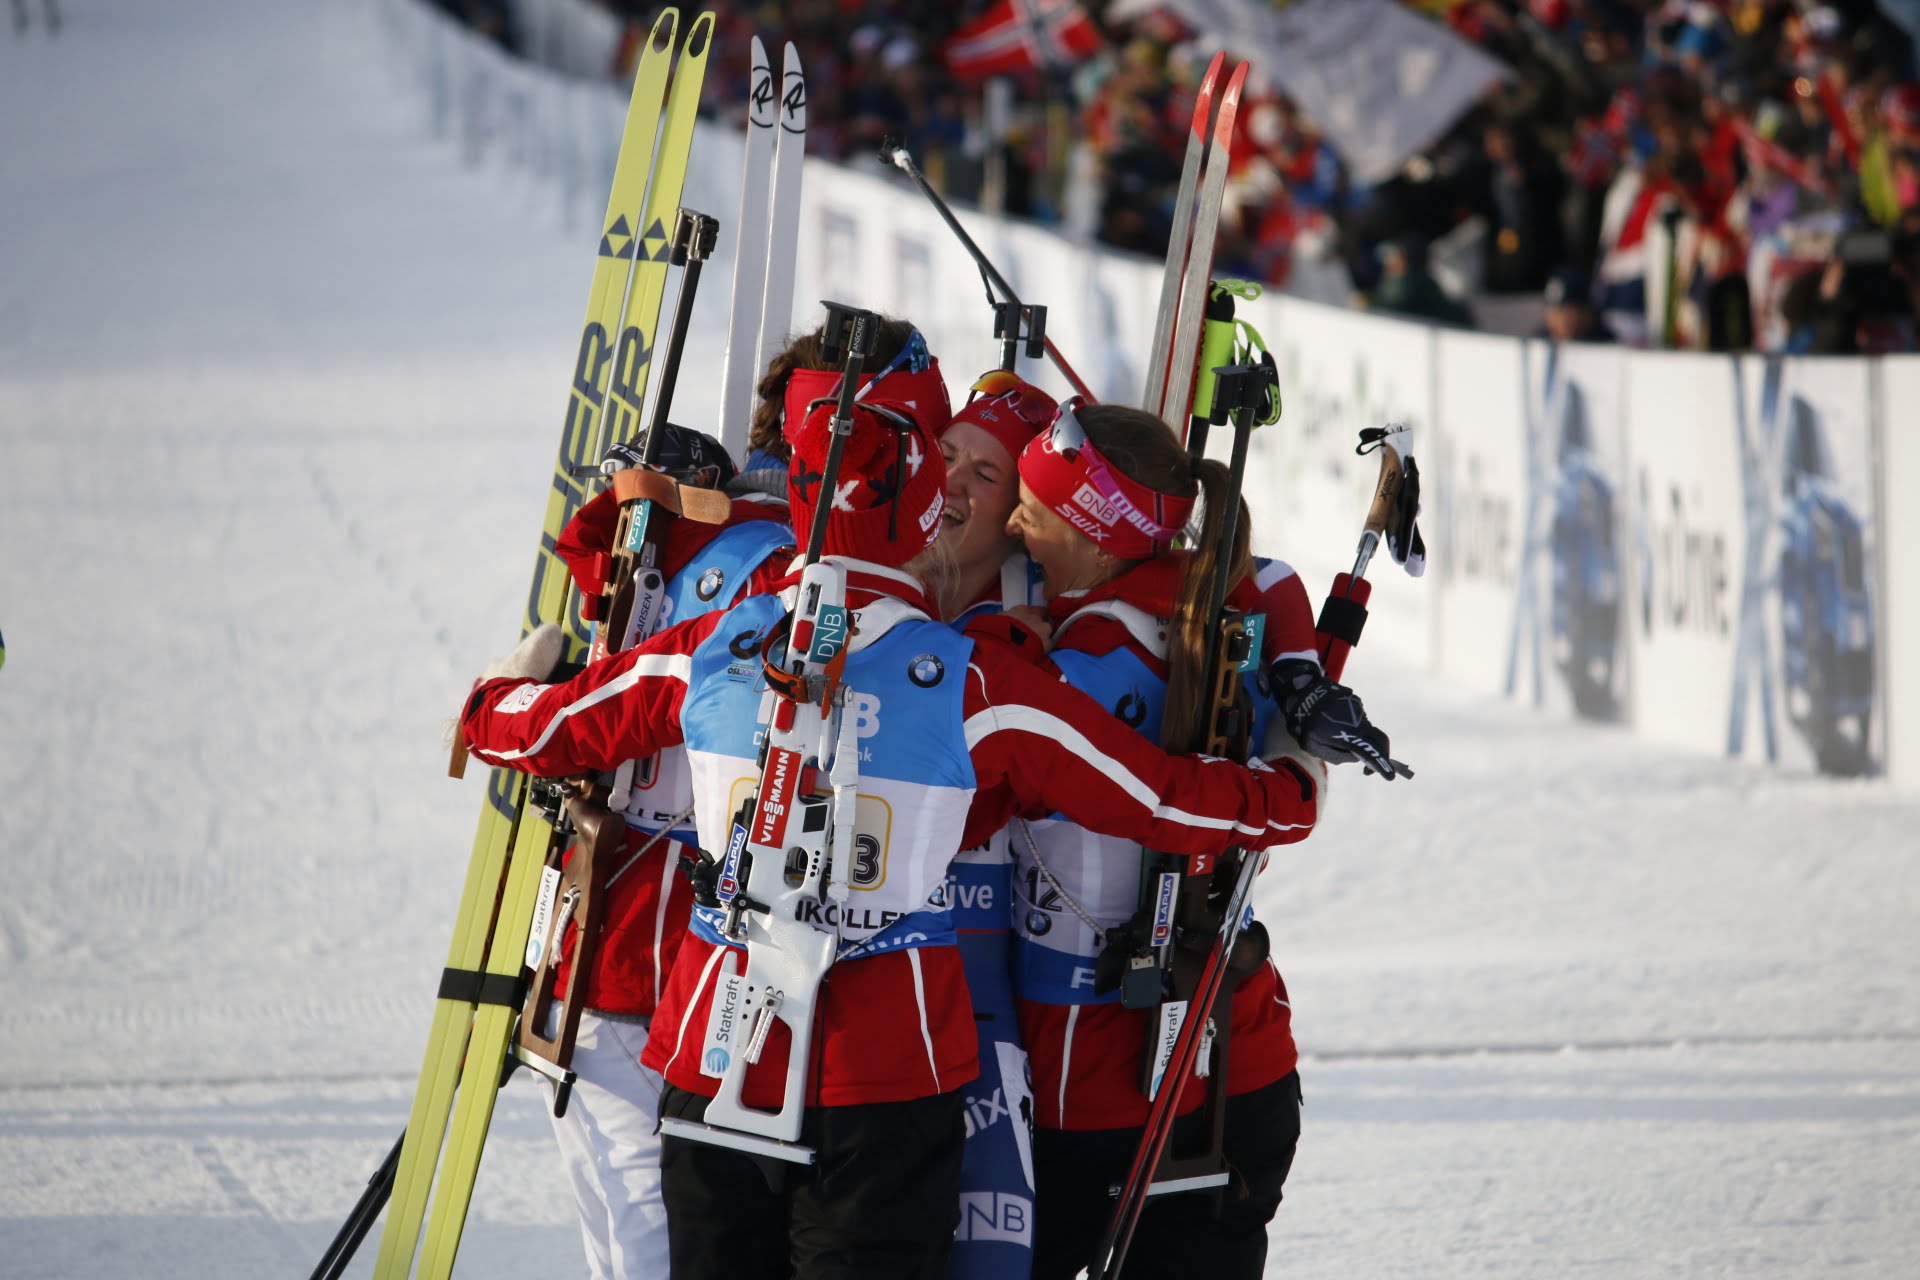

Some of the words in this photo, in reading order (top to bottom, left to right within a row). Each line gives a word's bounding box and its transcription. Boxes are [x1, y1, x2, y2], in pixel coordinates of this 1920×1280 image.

[1080, 490, 1115, 520] DNB
[1126, 511, 1162, 537] BLIZ
[816, 613, 846, 658] DNB
[727, 831, 743, 877] LAPUA
[535, 872, 553, 934] Statkraft
[1160, 878, 1173, 923] LAPUA
[716, 978, 740, 1043] Statkraft
[1161, 1005, 1179, 1068] Statkraft
